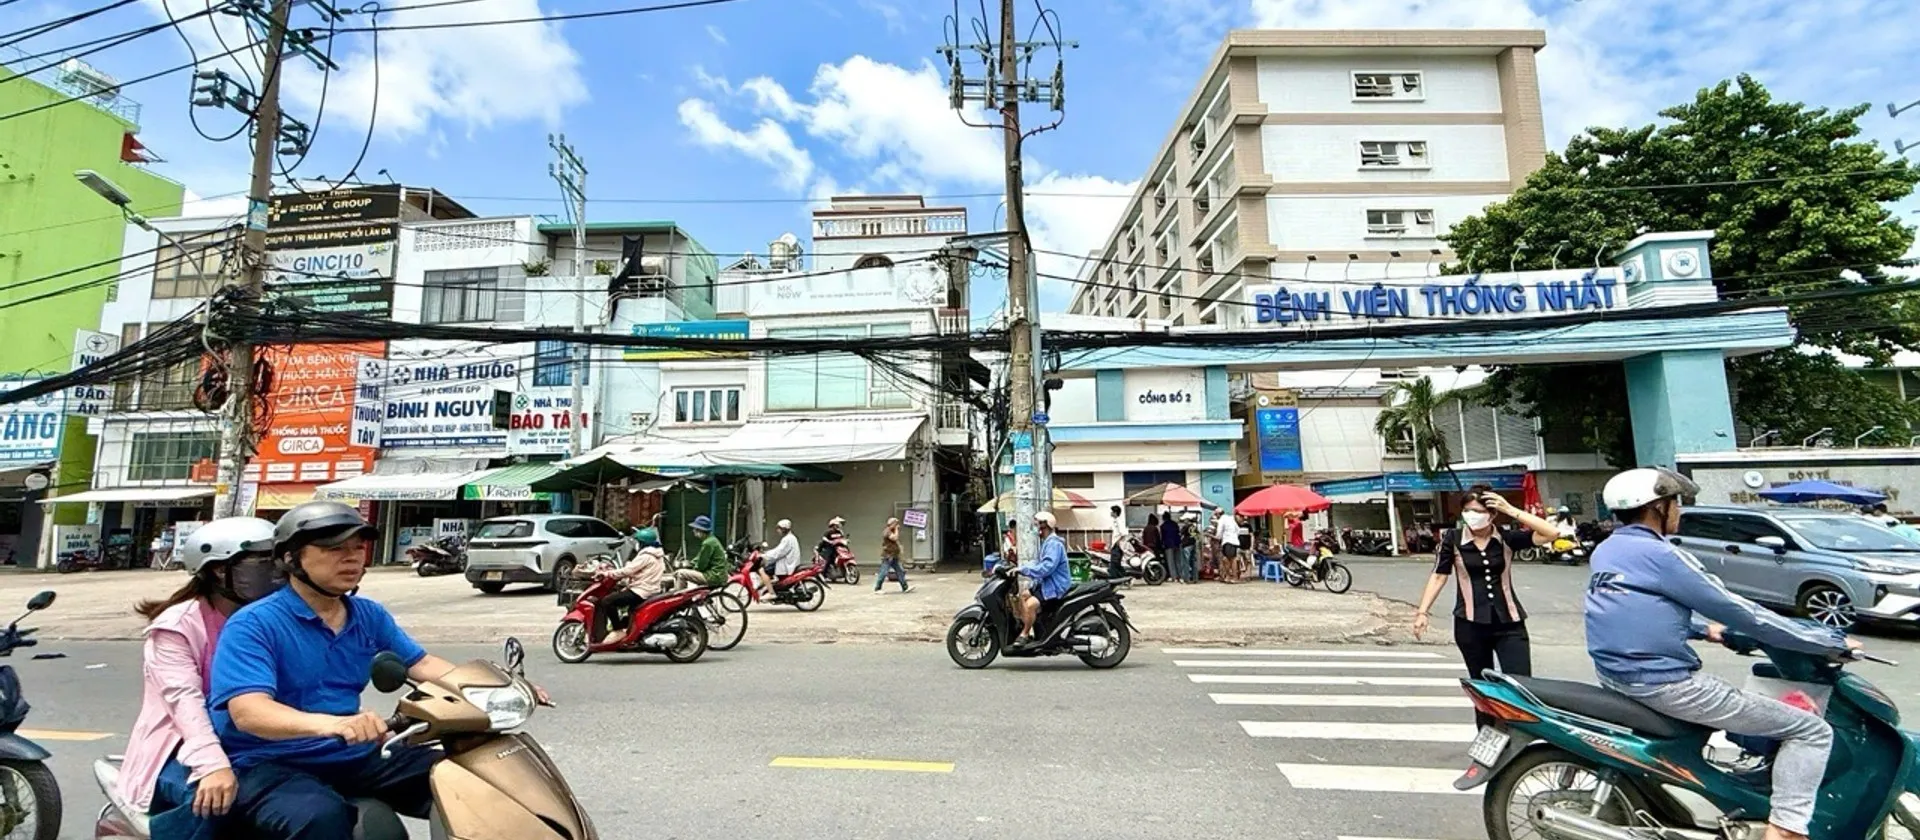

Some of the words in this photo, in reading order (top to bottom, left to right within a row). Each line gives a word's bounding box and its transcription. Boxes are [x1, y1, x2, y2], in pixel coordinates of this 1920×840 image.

[332, 198, 372, 209] GROUP
[293, 253, 363, 271] GINCI10
[1255, 287, 1331, 323] BỆNH
[1343, 282, 1409, 323] VIỆN
[1421, 273, 1526, 315] THỐNG
[1537, 274, 1616, 310] NHẤT
[415, 363, 450, 380] NHÀ
[457, 360, 515, 380] THUỐC
[276, 384, 346, 407] CIRCA
[534, 396, 552, 408] NHÀ
[1169, 389, 1183, 403] SỐ
[1185, 393, 1191, 403] 2
[387, 398, 429, 419] BÌNH
[434, 399, 496, 418] NGUY
[0, 409, 57, 441] ÁNG
[511, 409, 544, 430] BẢO
[281, 438, 320, 452] CIRCA
[357, 426, 375, 445] TÂY
